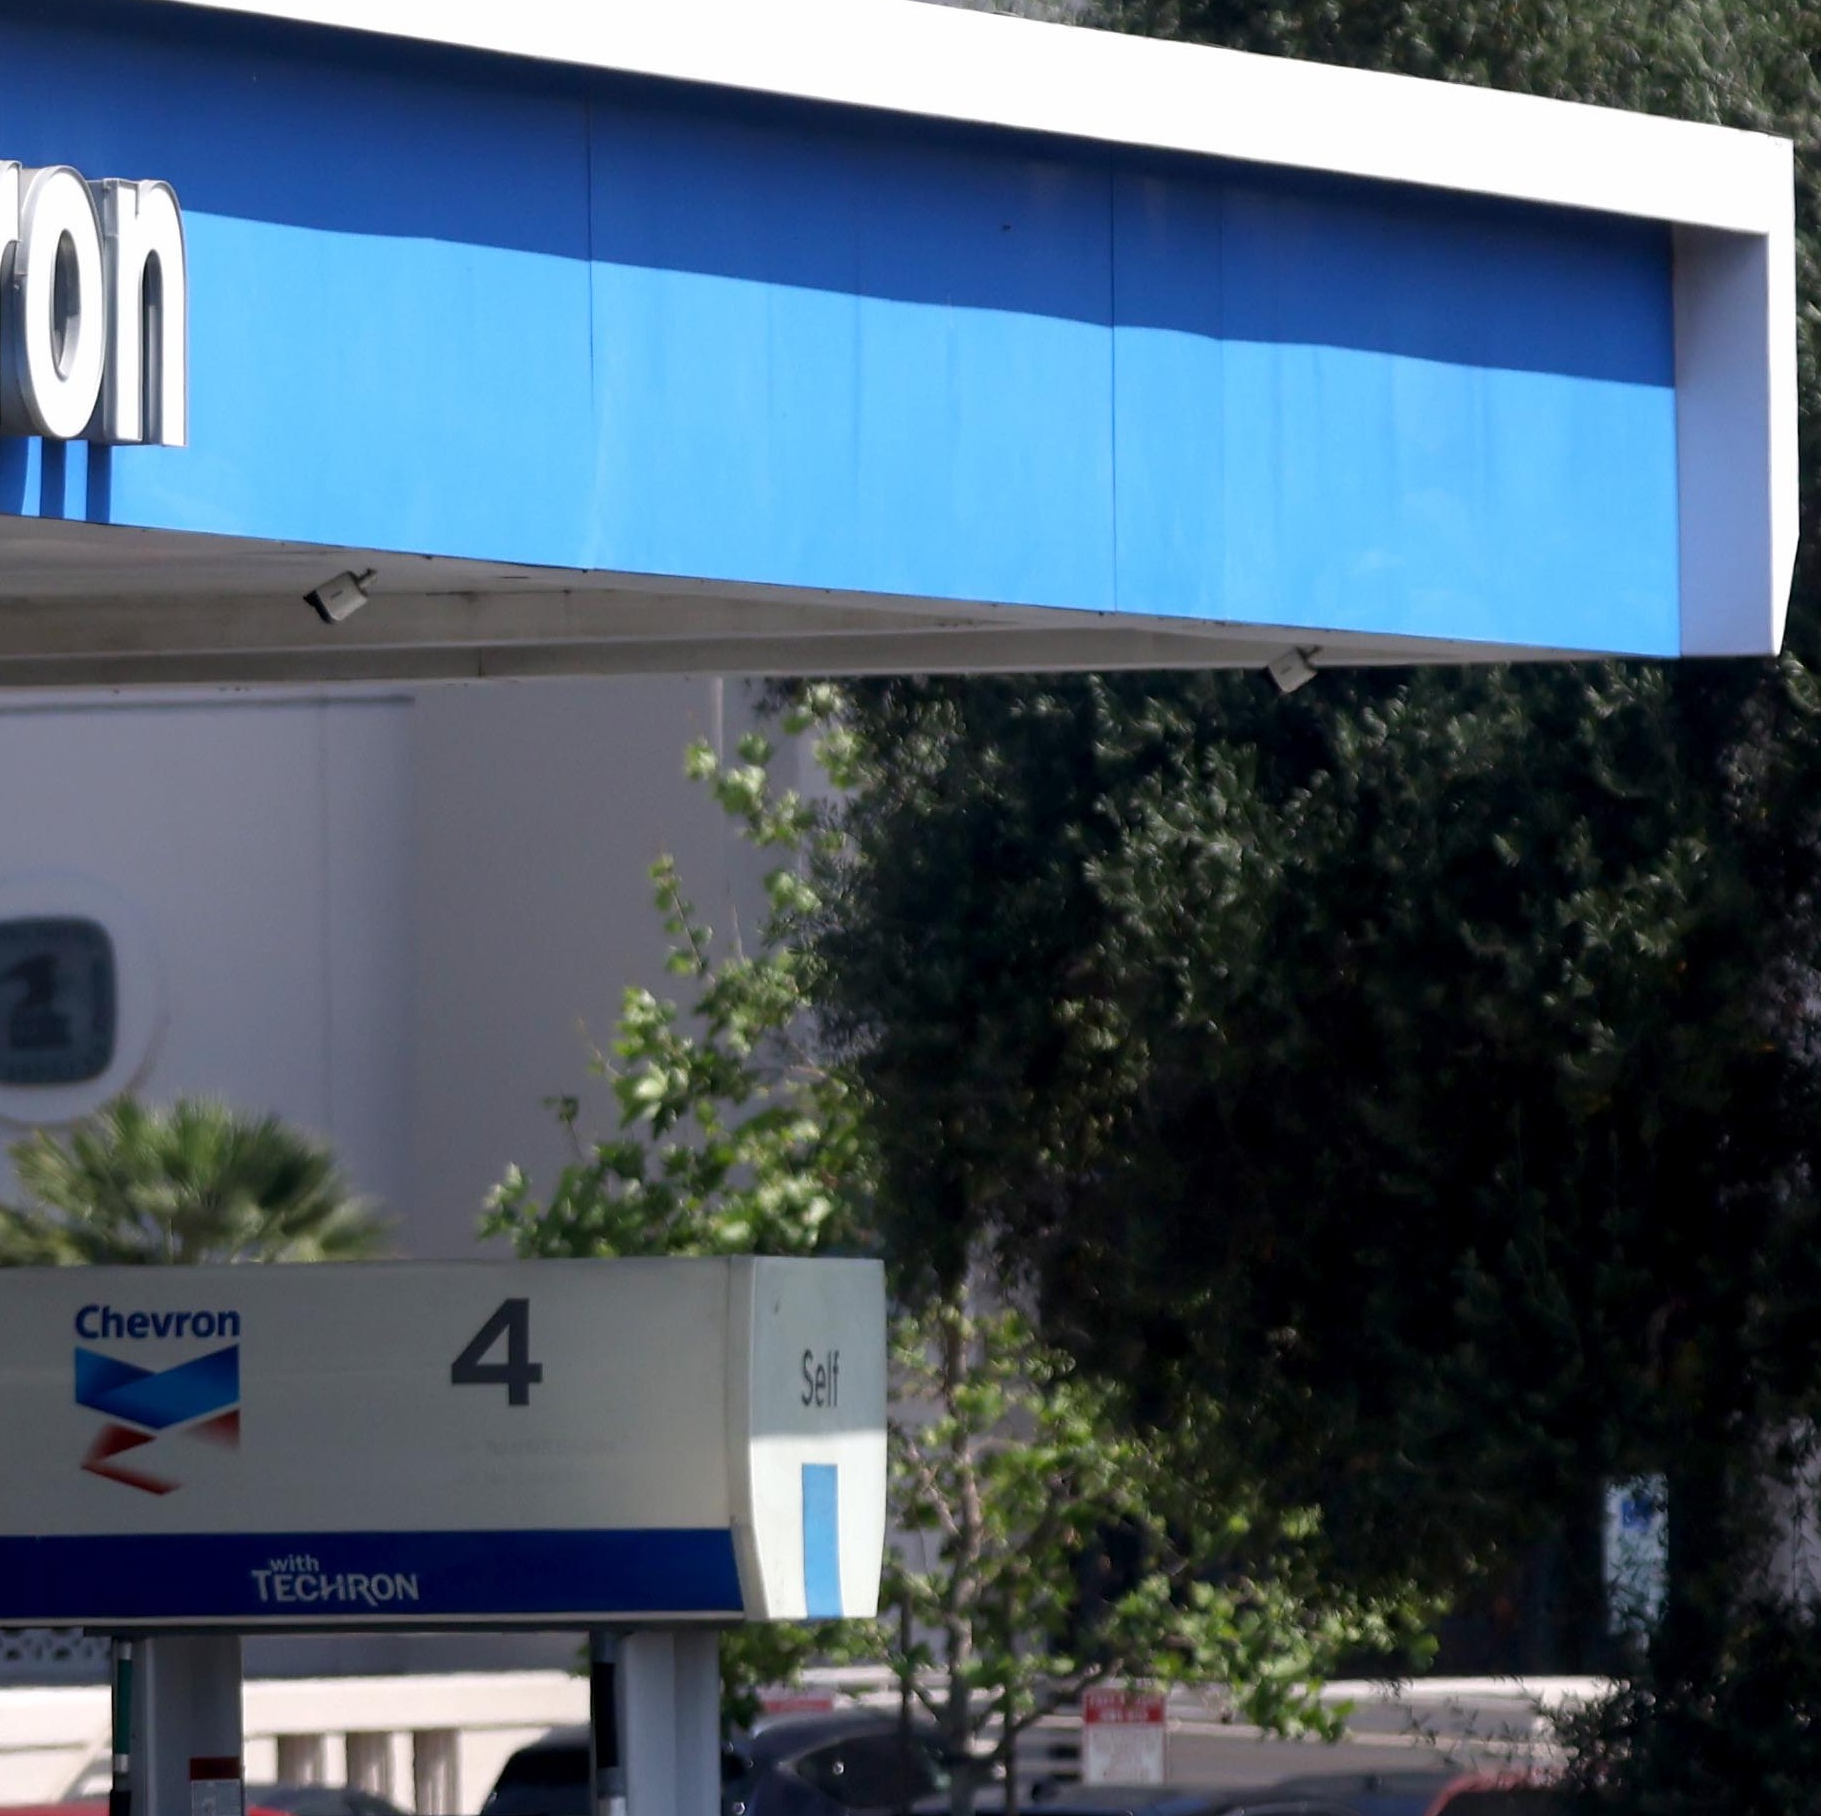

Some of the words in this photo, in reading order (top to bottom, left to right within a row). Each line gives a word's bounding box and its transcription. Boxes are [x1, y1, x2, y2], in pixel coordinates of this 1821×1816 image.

[74, 1303, 241, 1341] Chevron
[450, 1297, 544, 1407] 4
[800, 1348, 841, 1410] Self
[269, 1553, 320, 1574] with
[251, 1569, 420, 1608] TECHRON
